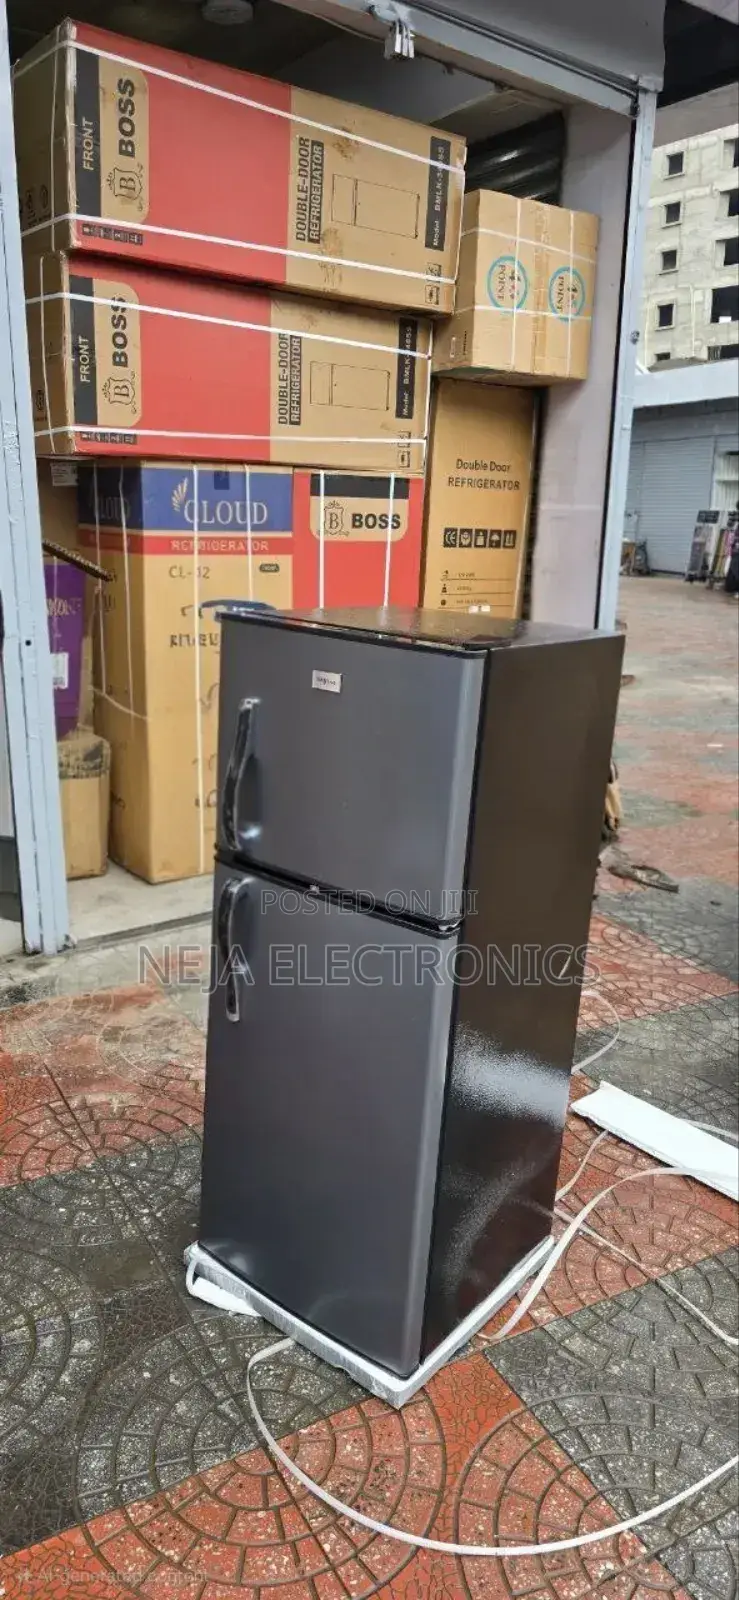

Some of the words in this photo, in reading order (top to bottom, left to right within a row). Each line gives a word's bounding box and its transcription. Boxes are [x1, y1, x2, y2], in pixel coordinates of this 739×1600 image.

[118, 77, 136, 159] BOSS
[83, 117, 95, 171] FRONT
[296, 137, 310, 241] DOUBLE-DOOR
[309, 144, 323, 240] REFRIGERATOR
[79, 336, 91, 383] FRONT
[278, 332, 289, 425] DOUBLE-DOOR
[290, 337, 301, 422] REFRIGERATOR
[447, 477, 520, 490] REFRIGERATOR
[456, 458, 488, 471] Double
[489, 461, 511, 472] Door
[184, 500, 267, 525] CLOUD
[351, 513, 401, 529] BOSS
[170, 540, 270, 551] RERIGERAOR
